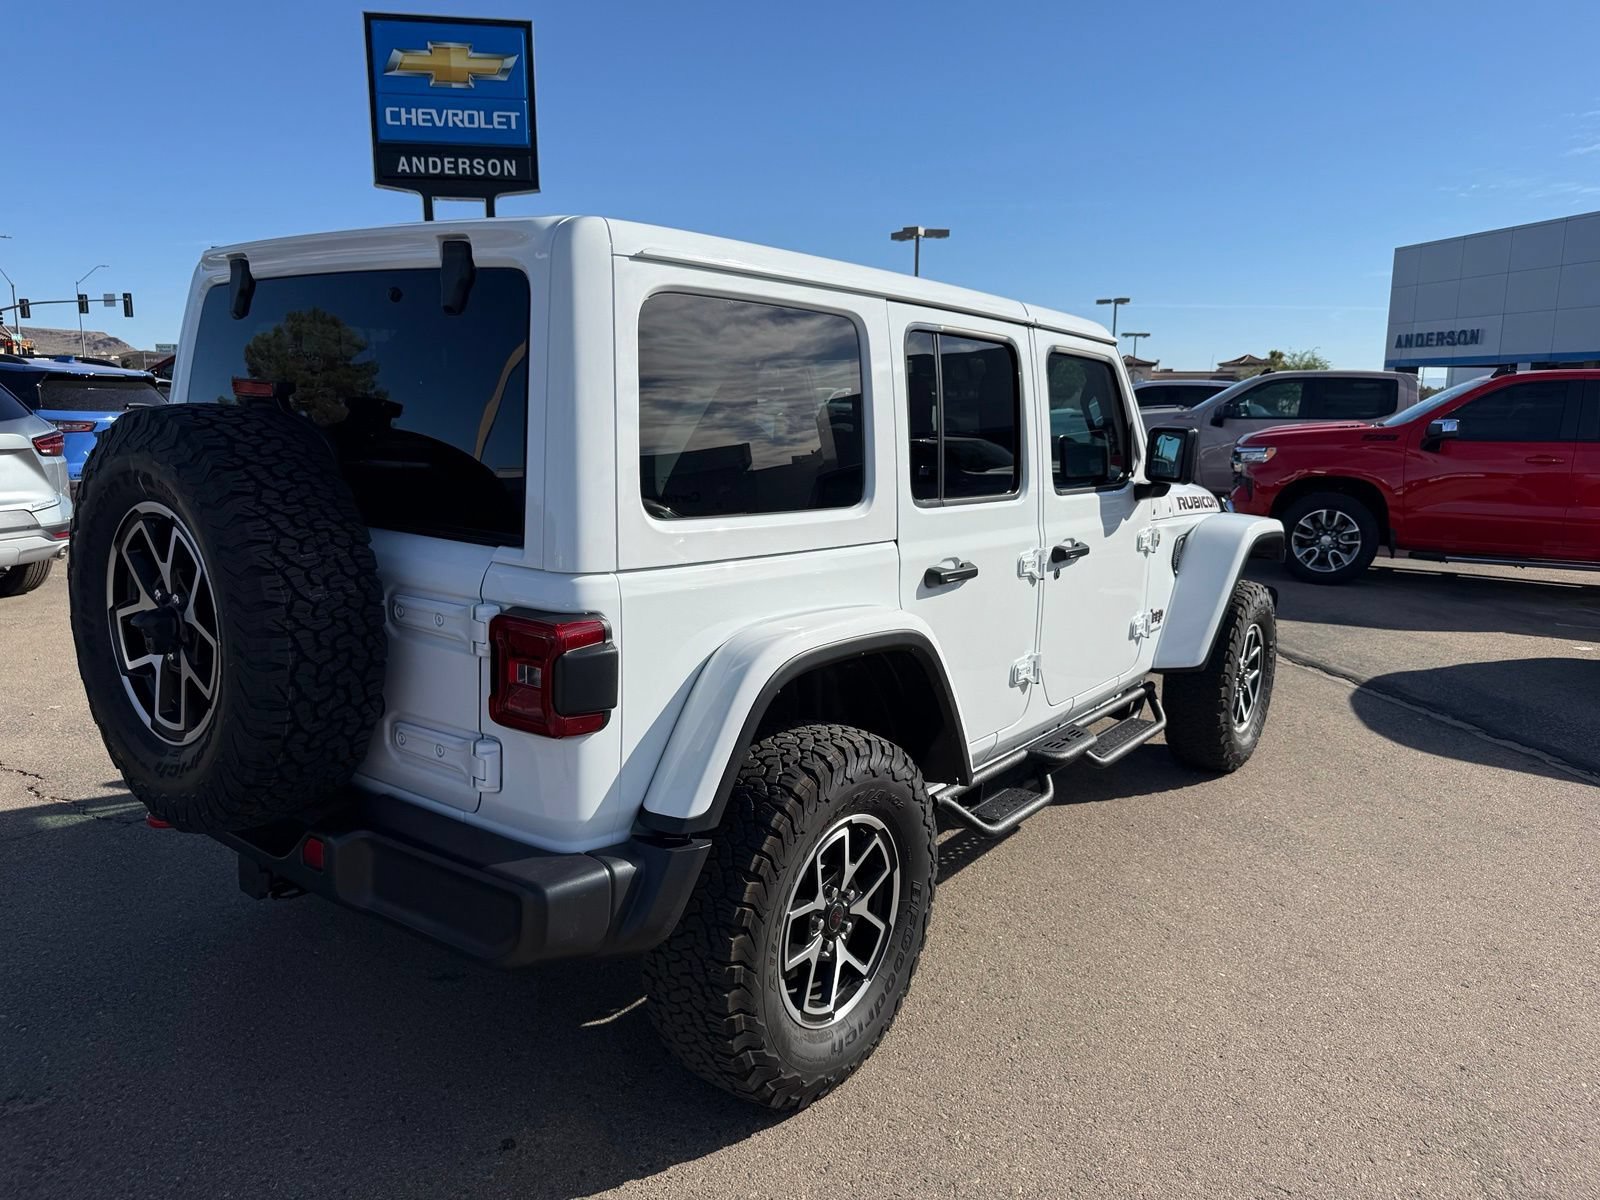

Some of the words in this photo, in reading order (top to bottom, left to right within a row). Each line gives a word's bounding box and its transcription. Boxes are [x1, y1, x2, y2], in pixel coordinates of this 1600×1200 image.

[385, 107, 520, 129] CHEVROLET
[397, 156, 517, 176] ANDERSON
[1395, 328, 1480, 348] ANDERSON
[1176, 496, 1218, 510] RUBICON
